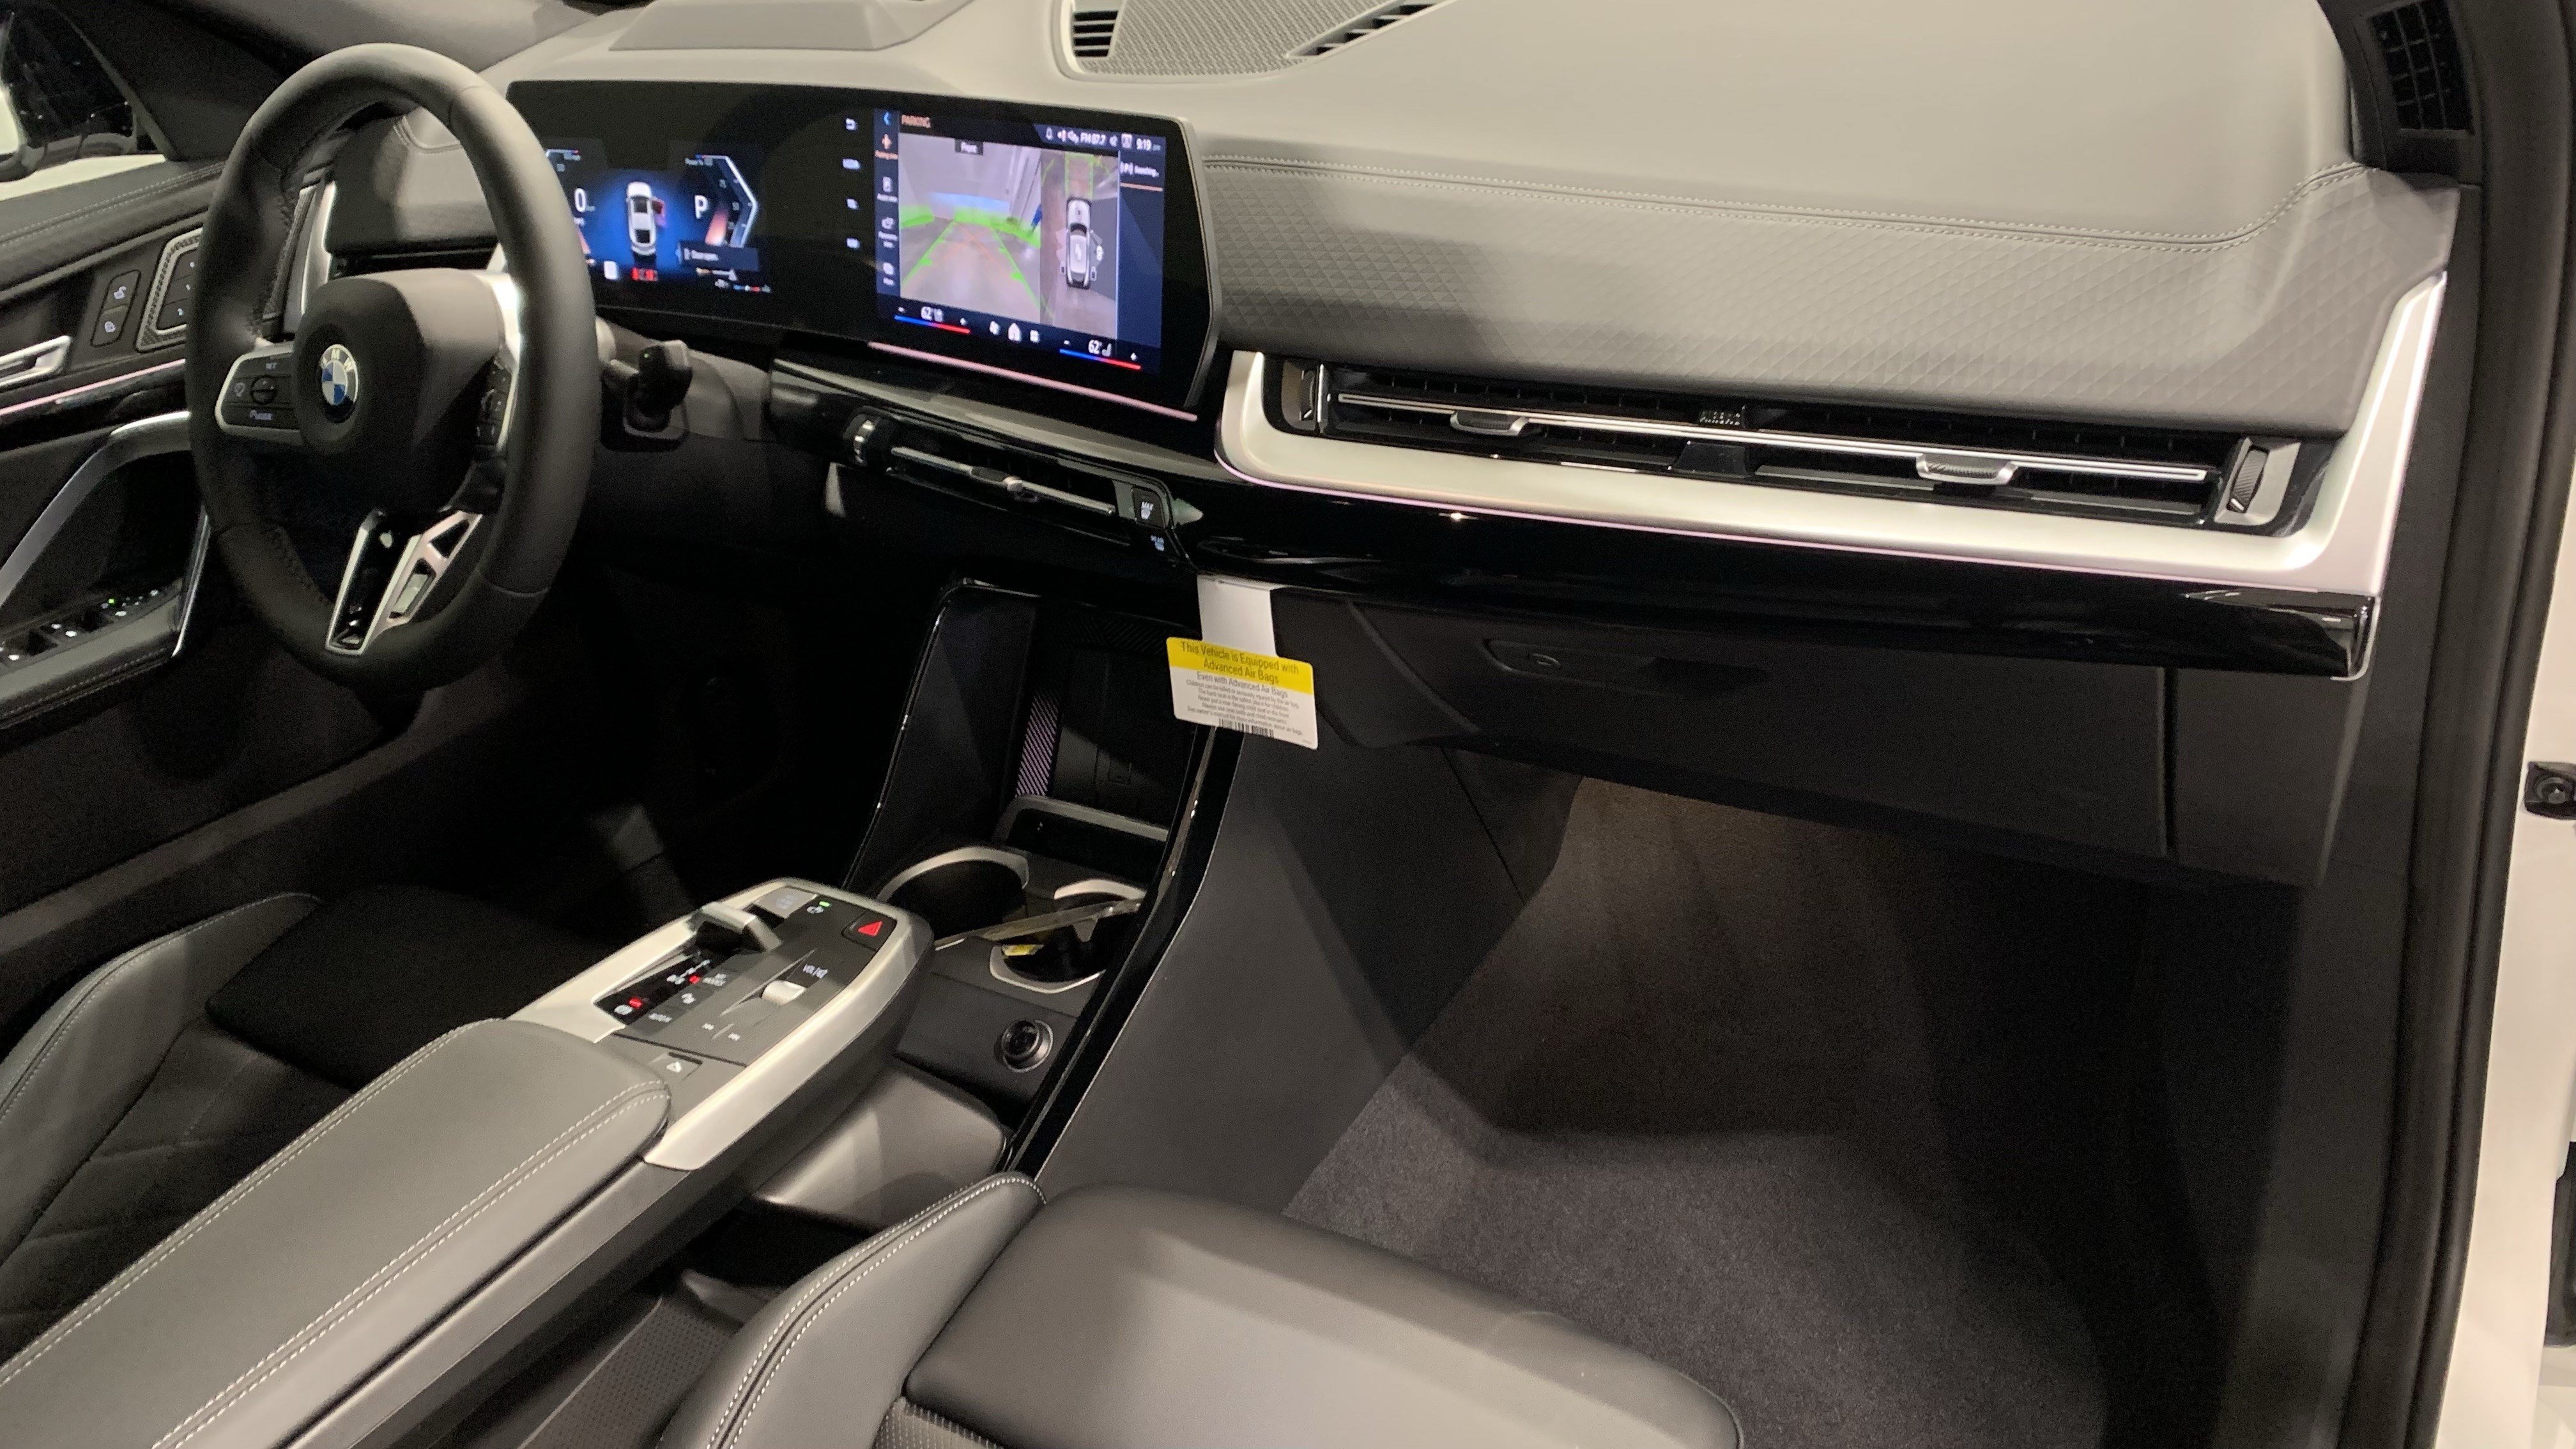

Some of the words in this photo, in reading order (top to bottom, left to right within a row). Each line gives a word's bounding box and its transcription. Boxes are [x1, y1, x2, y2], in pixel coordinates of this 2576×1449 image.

[694, 195, 709, 219] P
[1181, 641, 1199, 655] This
[1201, 645, 1230, 659] Vehicle
[1231, 652, 1238, 662] is
[1239, 654, 1279, 670] Equipped
[1280, 662, 1299, 675] with
[1204, 658, 1243, 676] Advanced
[1245, 668, 1256, 679] Air
[1257, 670, 1279, 685] Bags
[1228, 678, 1261, 692] Advanced
